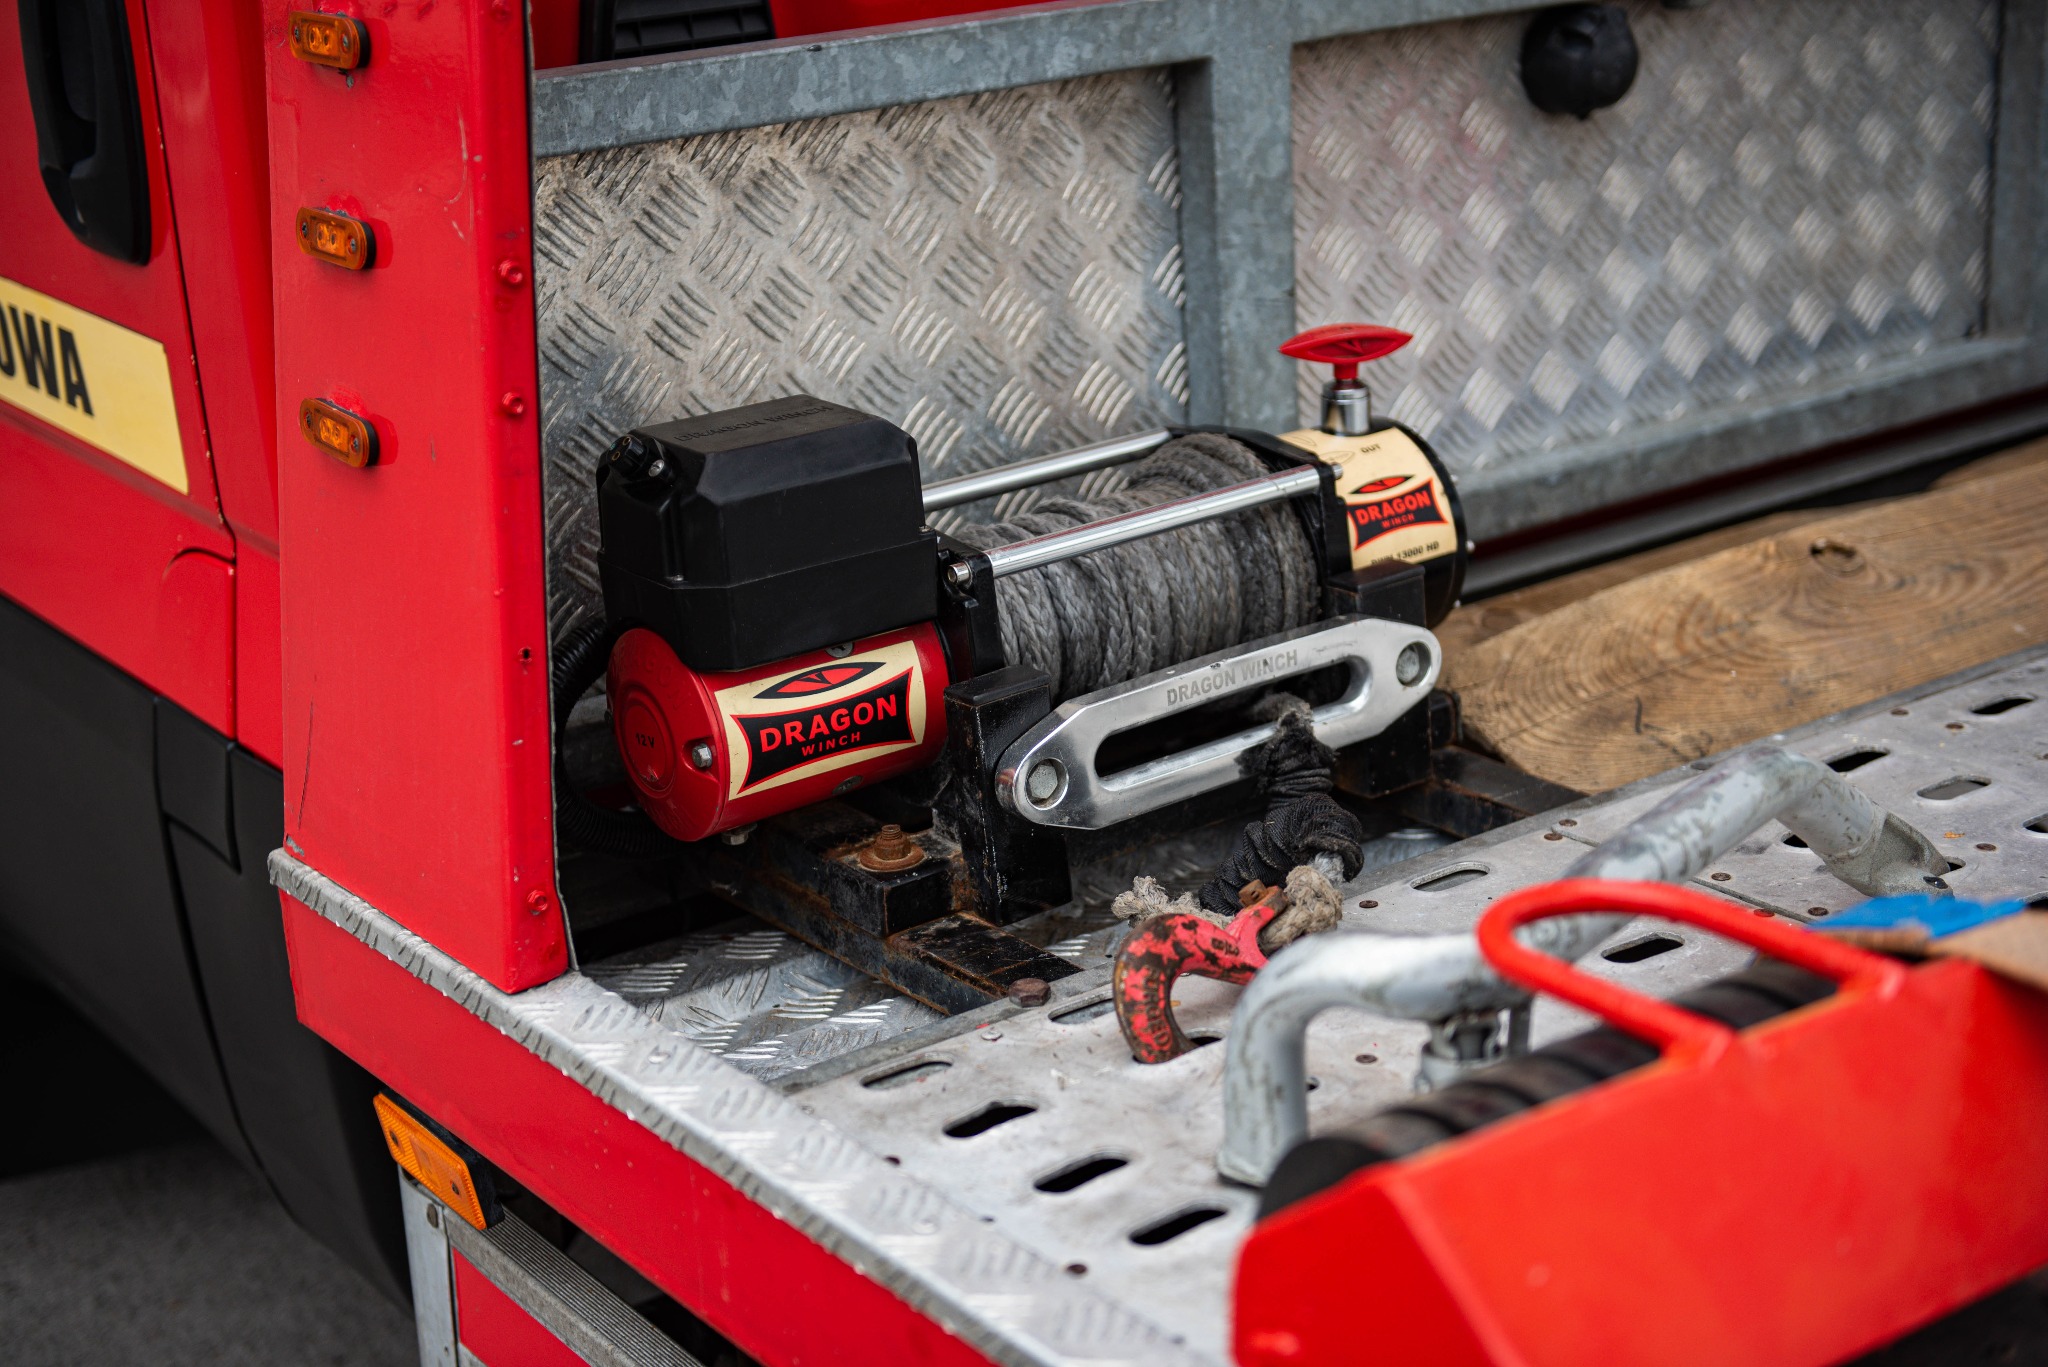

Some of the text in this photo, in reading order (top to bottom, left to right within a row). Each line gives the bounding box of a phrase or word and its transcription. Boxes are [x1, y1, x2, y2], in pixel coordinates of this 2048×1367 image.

[1360, 443, 1381, 454] OUT
[1355, 490, 1432, 526] DRAGON
[1381, 513, 1415, 528] WINCH
[1397, 545, 1424, 561] 13000
[1426, 541, 1440, 552] HD
[1166, 649, 1298, 706] DRAGON WINCH
[759, 694, 898, 753] DRAGON
[801, 731, 861, 757] WINCH
